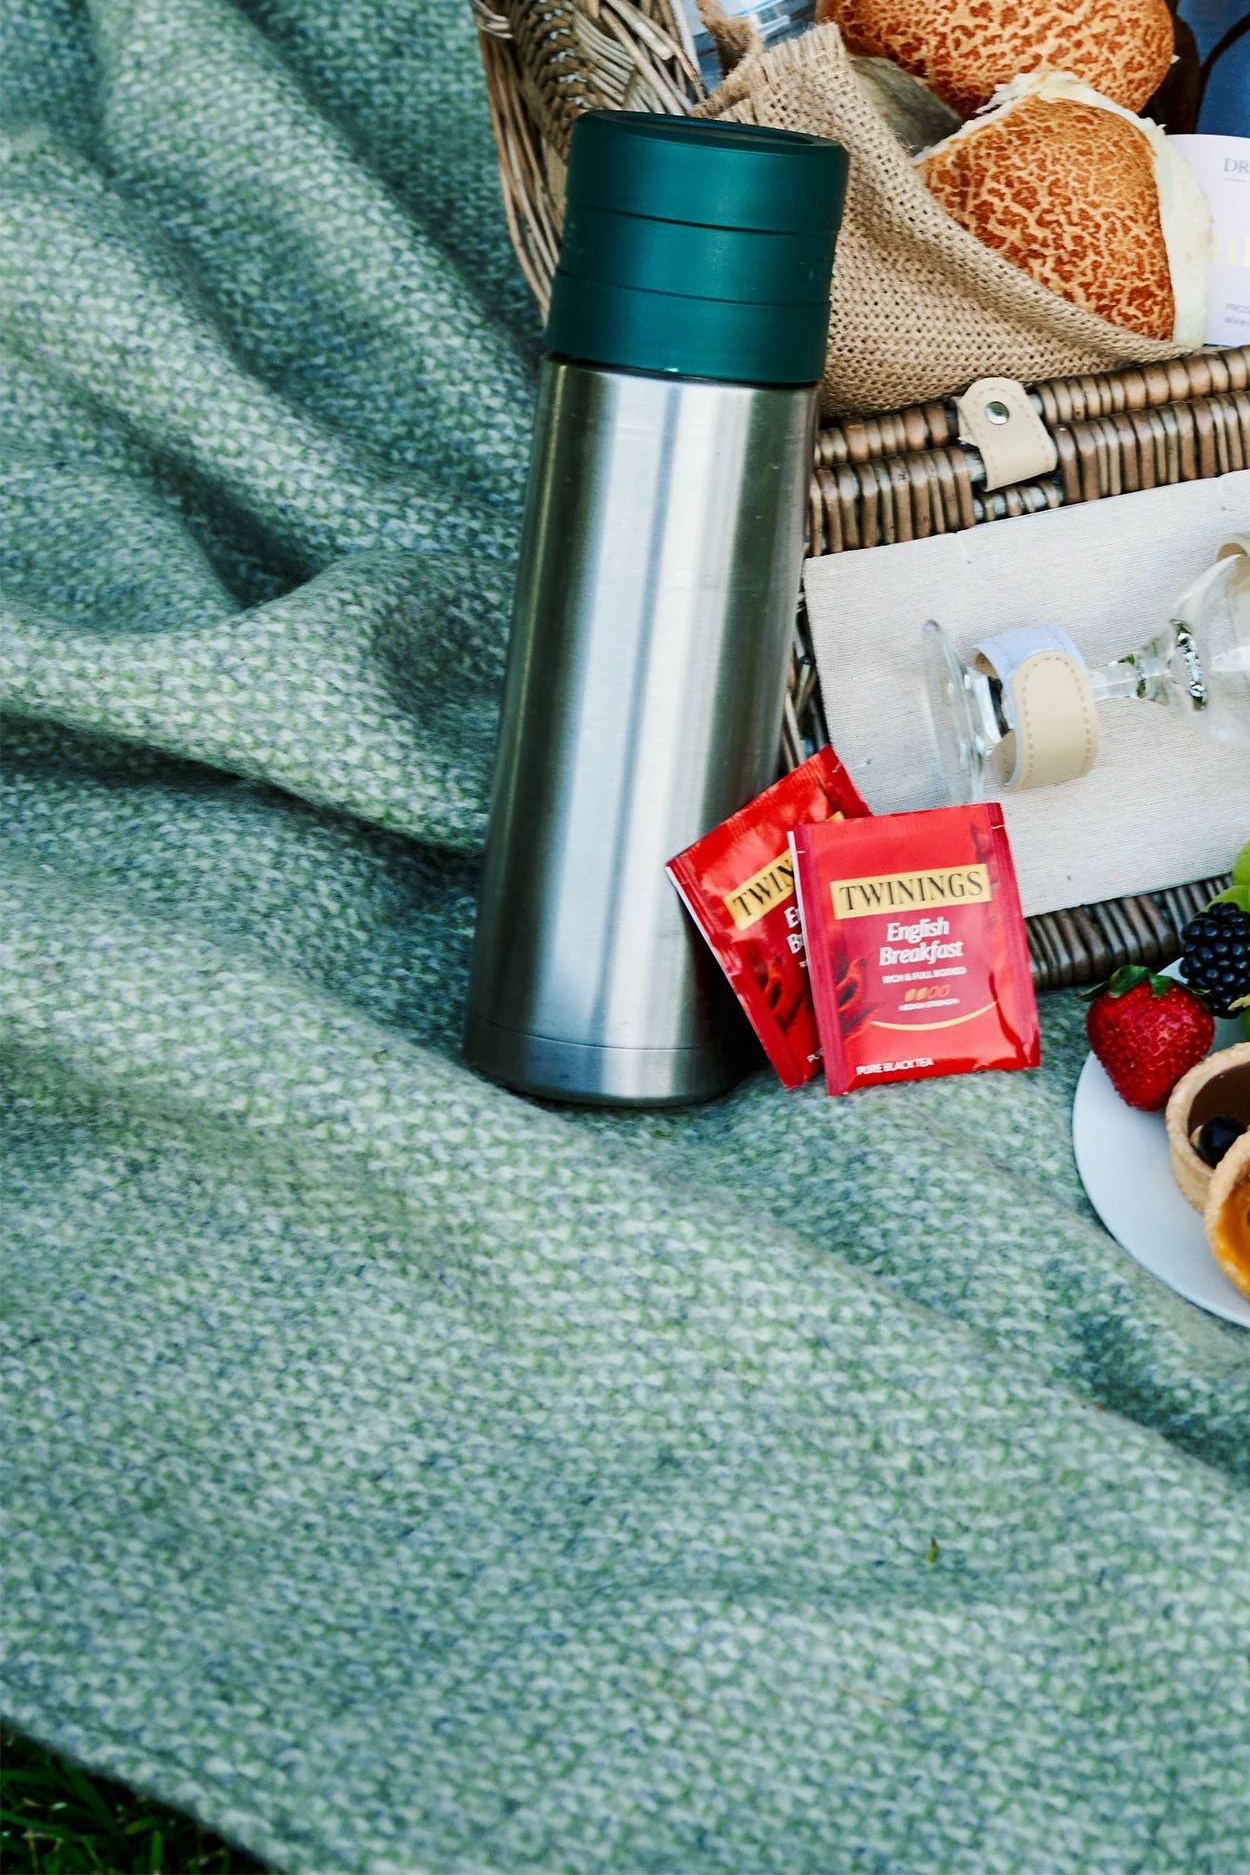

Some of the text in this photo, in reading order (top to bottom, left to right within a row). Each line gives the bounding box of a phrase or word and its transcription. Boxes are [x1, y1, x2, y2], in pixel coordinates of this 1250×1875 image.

[733, 858, 795, 917] TWIN
[839, 871, 984, 912] TWININGS
[886, 916, 951, 944] English
[879, 940, 966, 967] Breakfast
